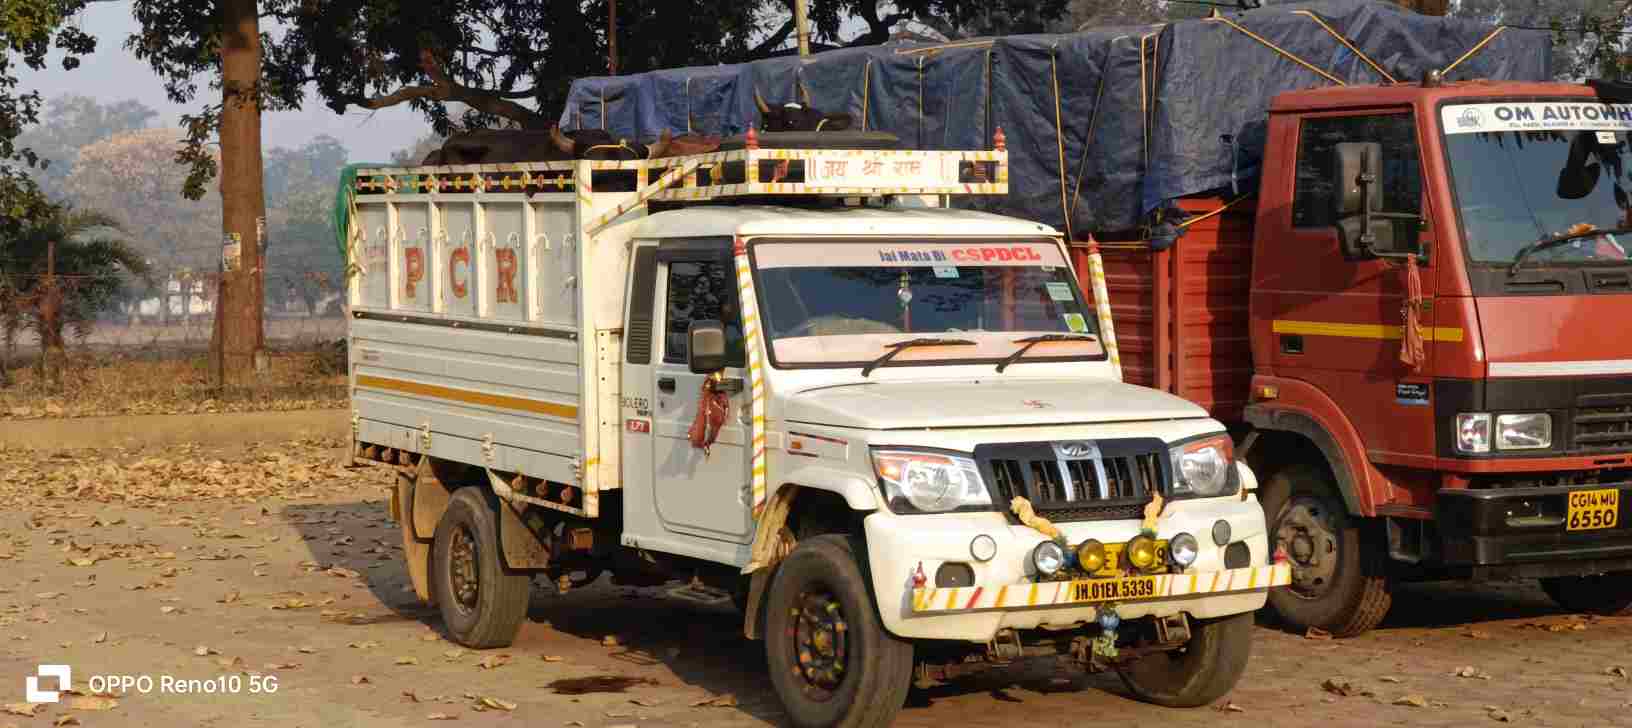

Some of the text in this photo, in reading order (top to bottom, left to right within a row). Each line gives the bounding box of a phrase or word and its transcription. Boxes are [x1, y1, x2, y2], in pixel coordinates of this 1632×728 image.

[1494, 106, 1535, 121] OM
[951, 247, 1041, 261] CSPDCL
[1571, 491, 1616, 507] CG14 MU
[1570, 508, 1615, 528] 6550
